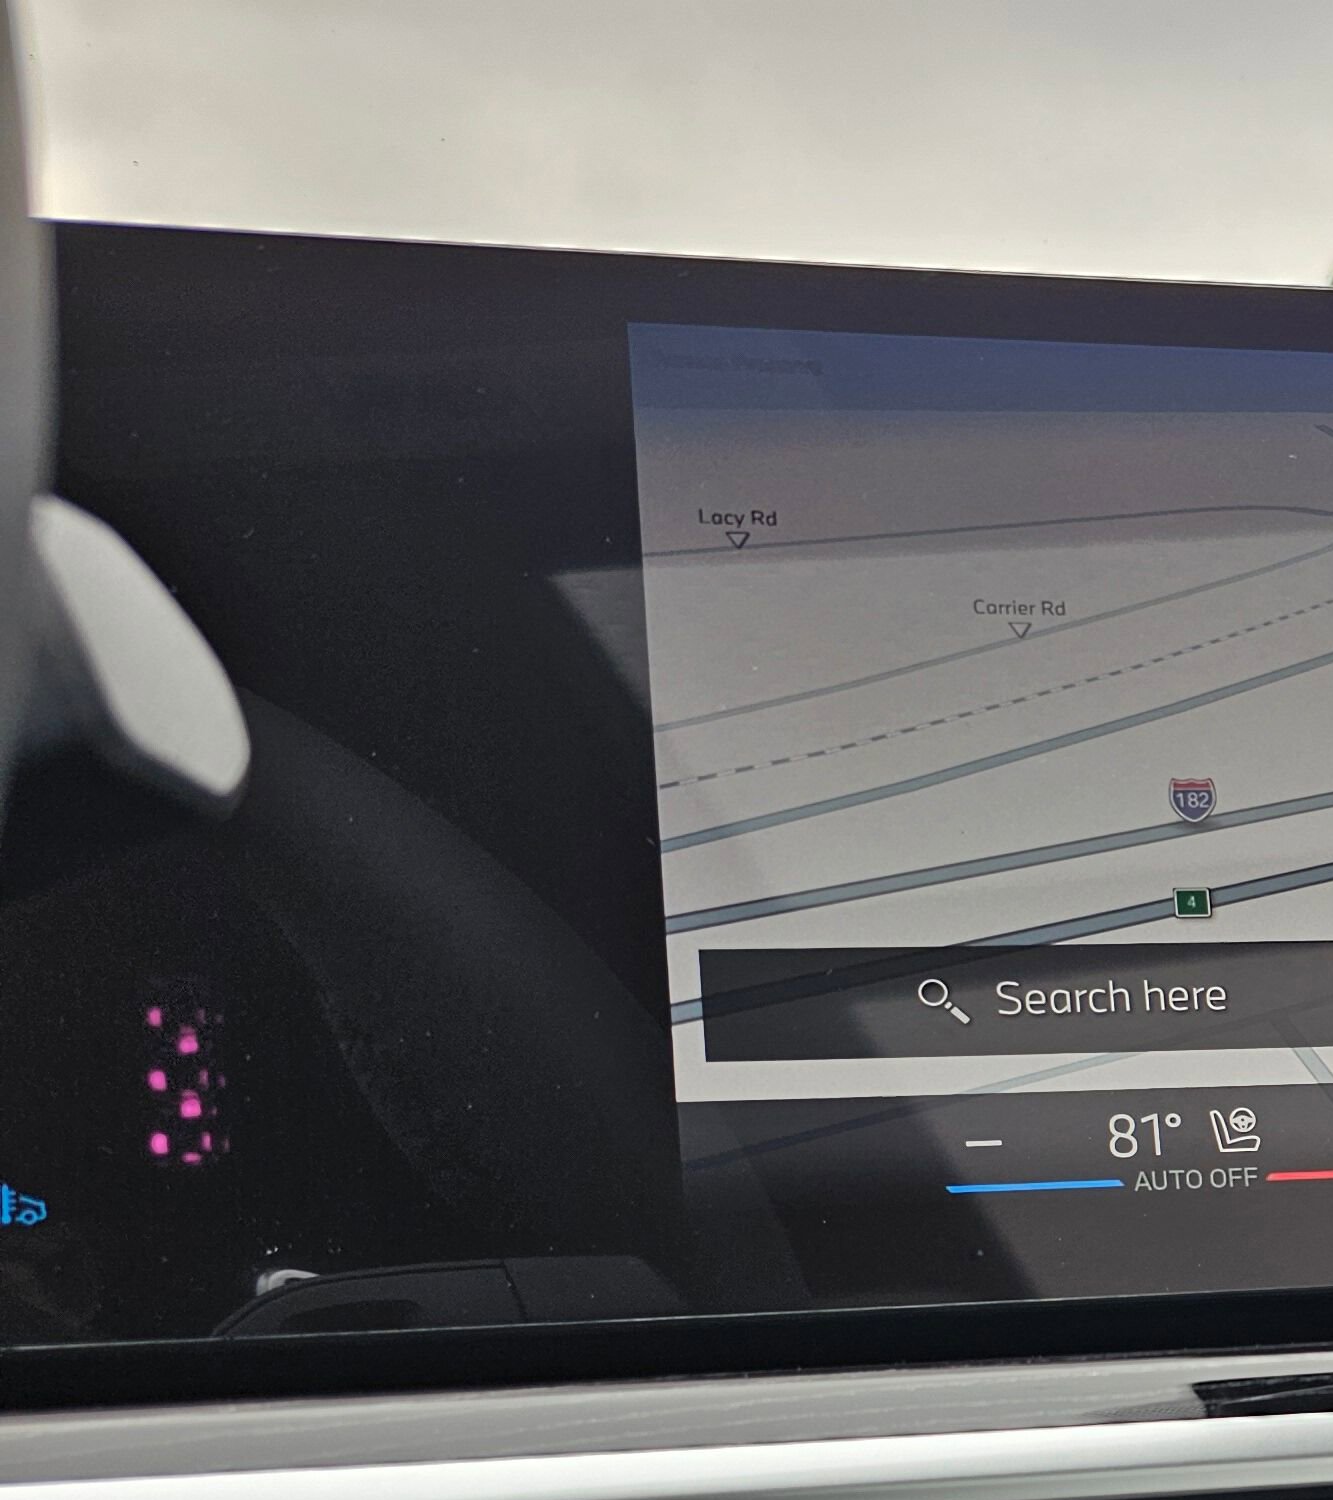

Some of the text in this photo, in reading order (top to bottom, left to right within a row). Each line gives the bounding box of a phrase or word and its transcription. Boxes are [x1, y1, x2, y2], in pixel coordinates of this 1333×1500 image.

[698, 508, 777, 528] Lacy Rd
[973, 598, 1067, 617] Carrier Rd
[1176, 791, 1209, 809] 182
[1186, 895, 1196, 909] 4
[996, 979, 1227, 1015] Search here
[1134, 1167, 1257, 1192] AUTO OFF
